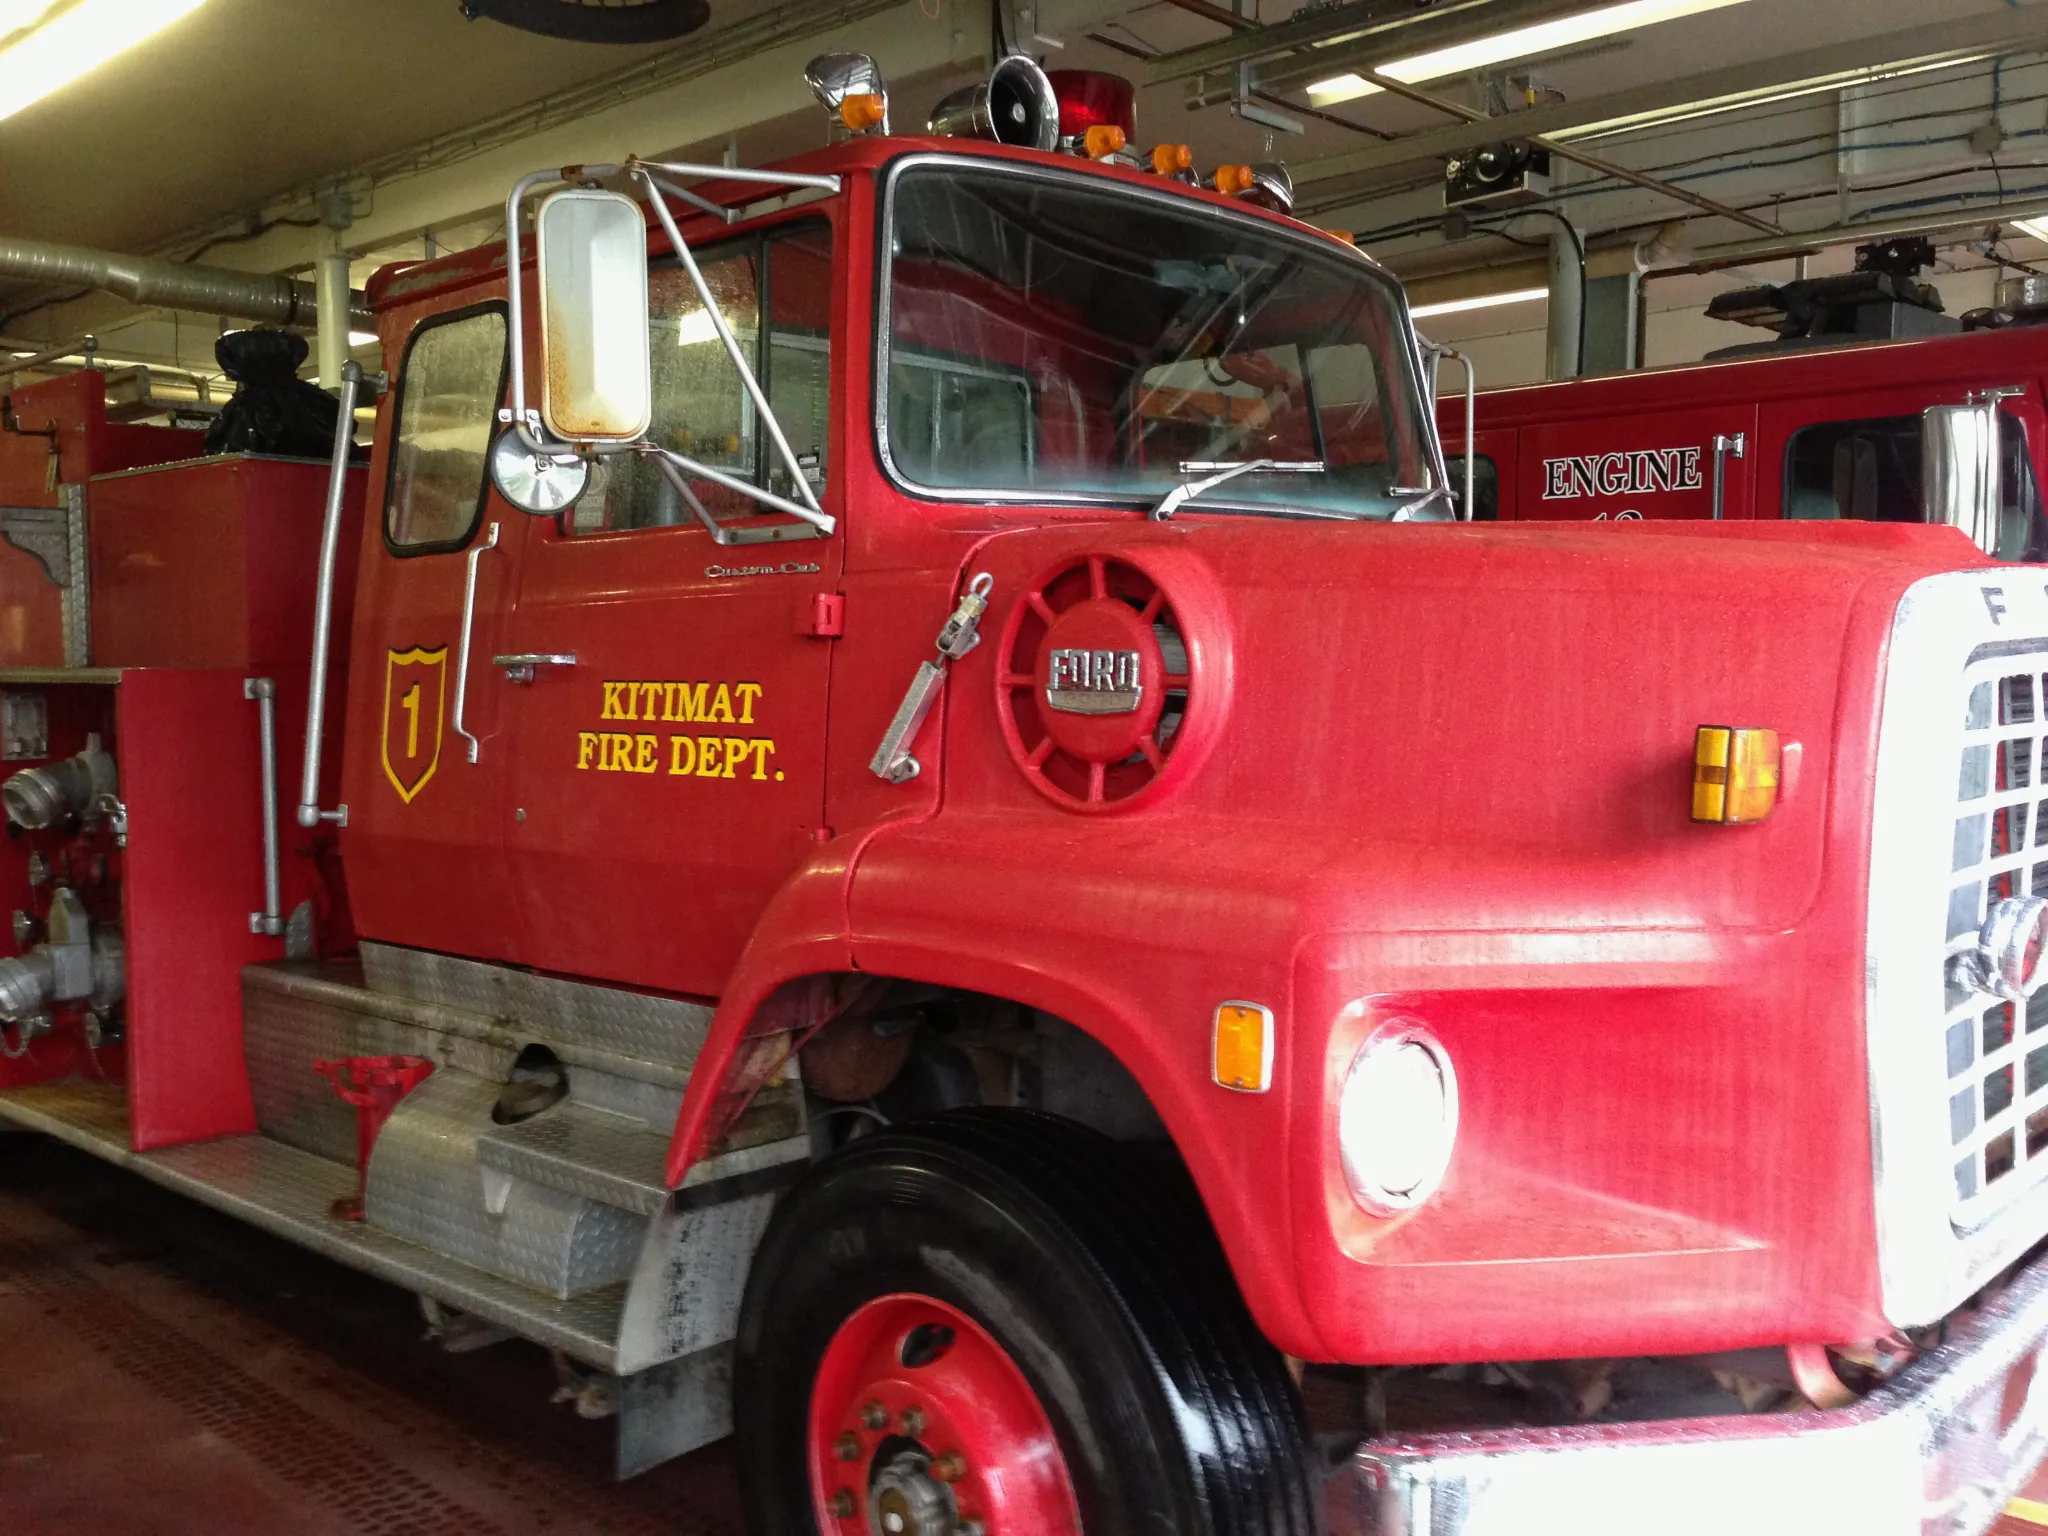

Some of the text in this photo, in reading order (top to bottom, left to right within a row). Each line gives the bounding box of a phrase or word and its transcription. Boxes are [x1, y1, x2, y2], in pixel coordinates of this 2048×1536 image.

[1542, 446, 1702, 500] ENGINE
[1049, 649, 1140, 691] FORD
[402, 681, 420, 758] 1
[600, 681, 763, 724] KITIMAT
[576, 732, 785, 782] FIRE DEPT.
